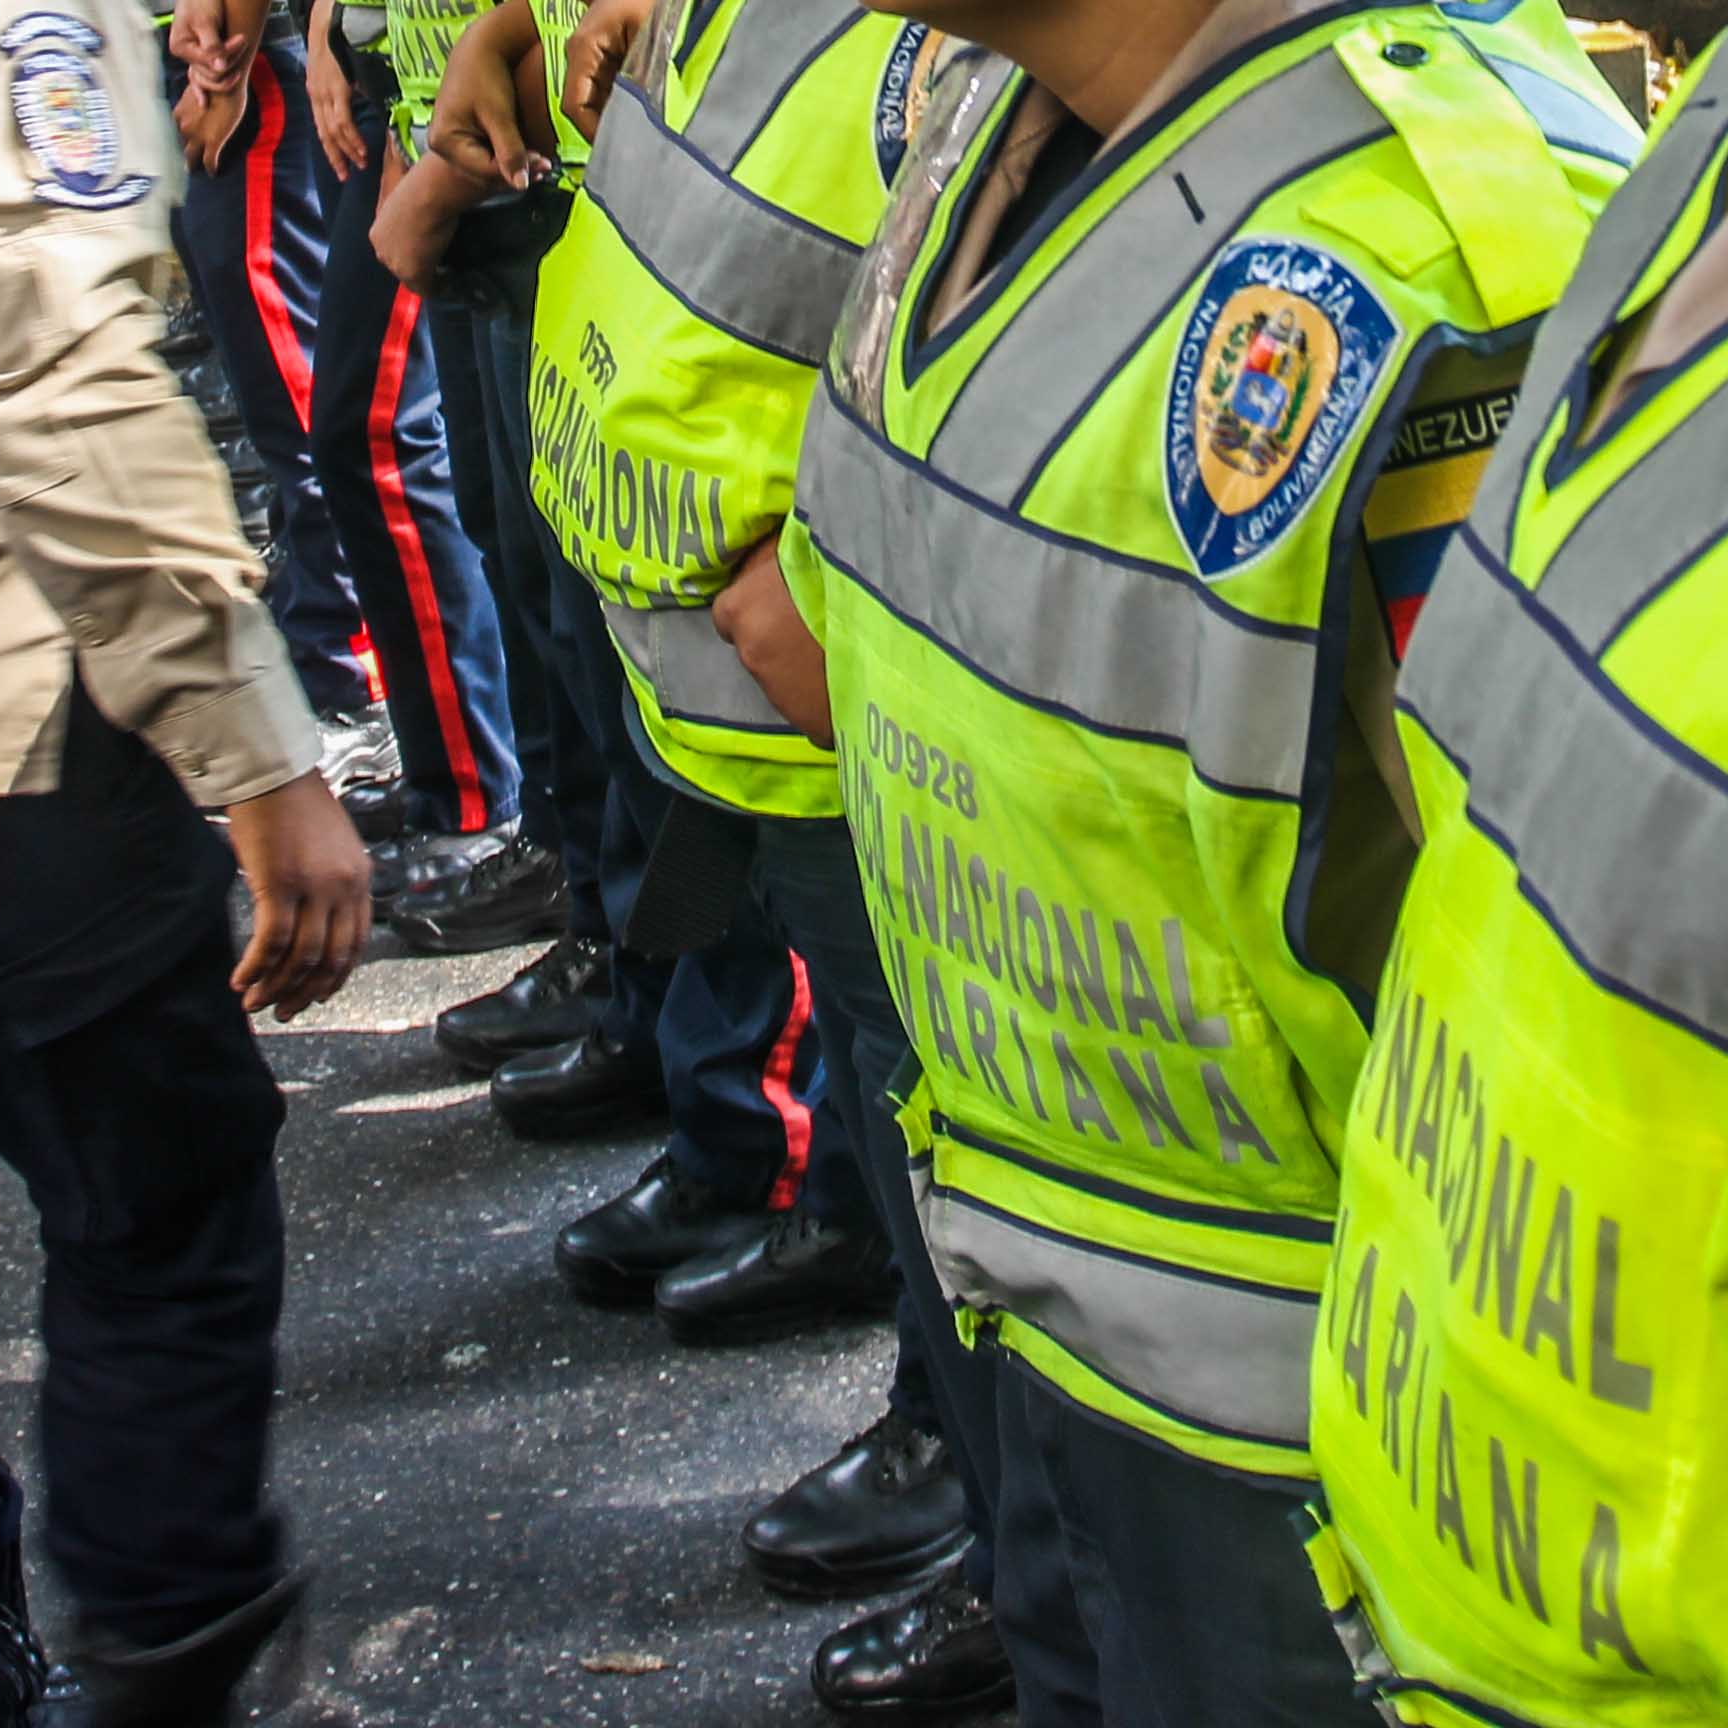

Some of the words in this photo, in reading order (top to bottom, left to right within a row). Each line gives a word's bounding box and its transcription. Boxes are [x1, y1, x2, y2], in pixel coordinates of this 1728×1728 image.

[866, 701, 979, 821] 00928
[900, 812, 1232, 1048] NACIONAL
[1375, 988, 1654, 1413] NACIONAL
